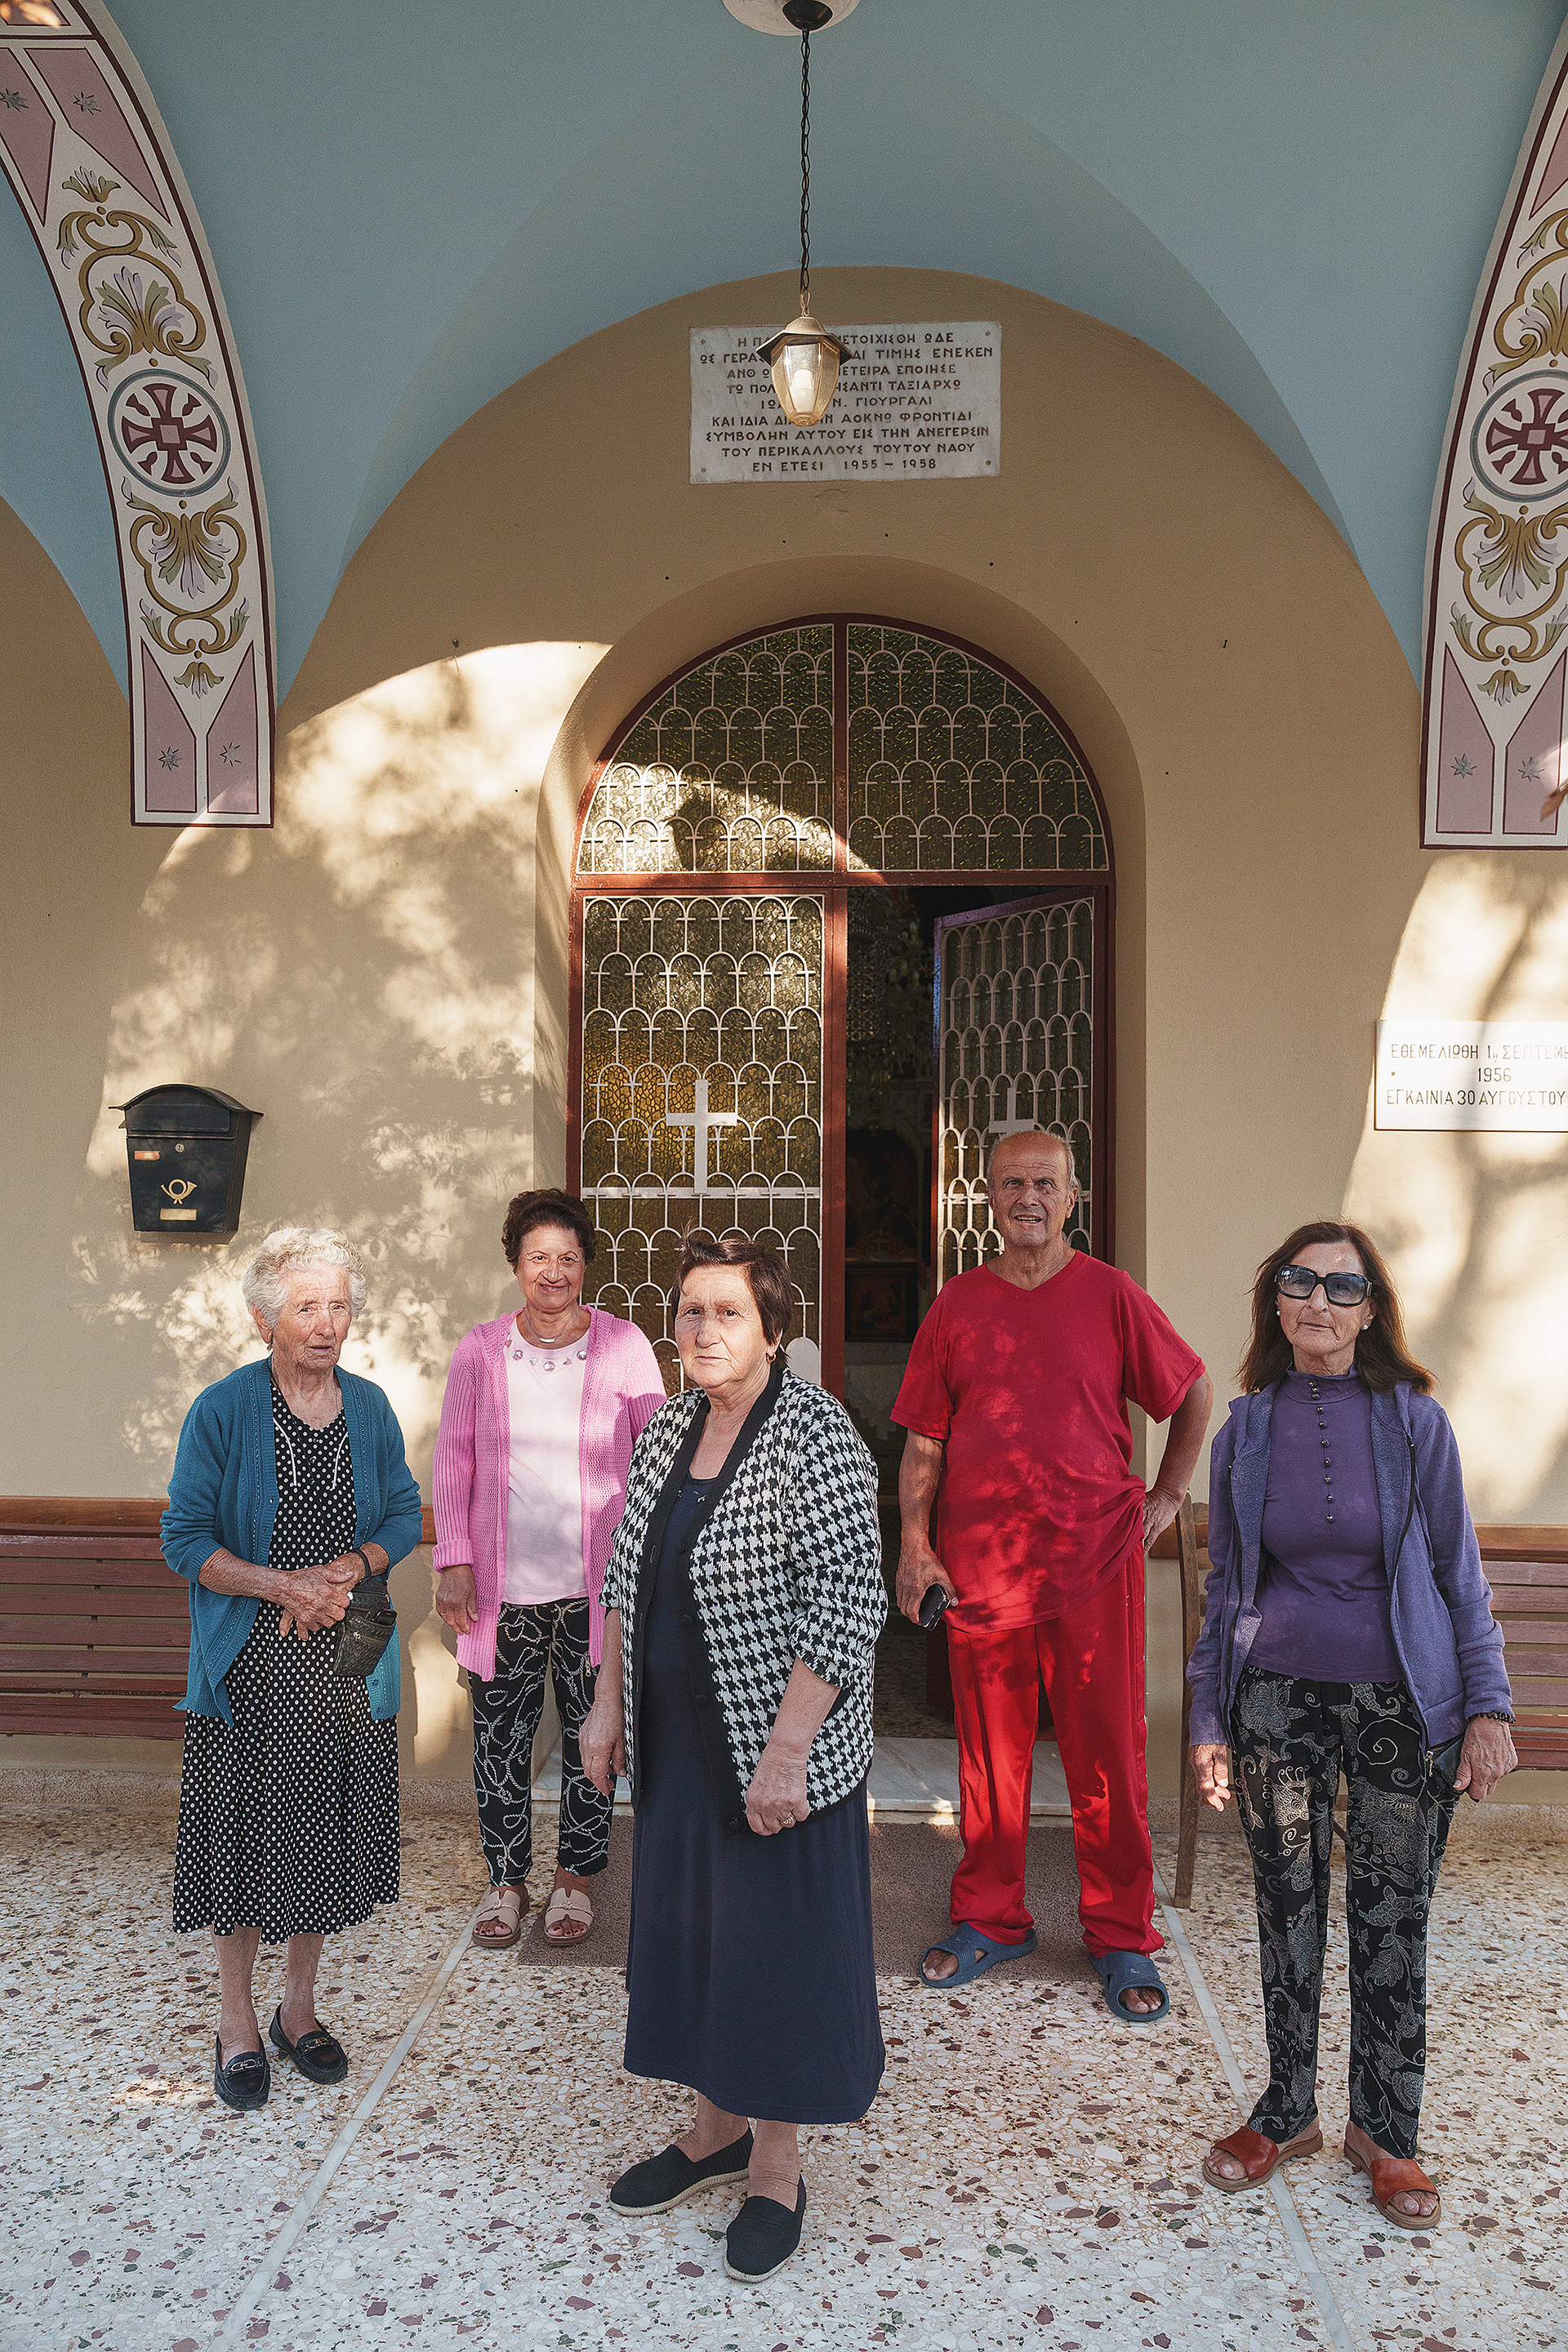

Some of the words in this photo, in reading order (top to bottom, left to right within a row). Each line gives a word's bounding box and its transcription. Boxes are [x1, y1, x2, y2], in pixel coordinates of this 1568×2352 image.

[738, 337, 746, 347] Η
[840, 333, 915, 345] ΕΤΟΙΧΙΣΘΗ
[924, 332, 954, 343] ΩΔΕ
[700, 354, 715, 364] ΩΣ
[852, 350, 866, 359] ΑΙ
[875, 348, 920, 359] ΤΙΜΗΣ
[933, 347, 993, 358] ΕΝΕΚΕΝ
[727, 369, 755, 379] ΑΝΘ
[838, 366, 890, 376] ΕΤΕΙΡΑ
[897, 363, 956, 375] ΕΠΟΙΗΣΕ
[727, 384, 743, 394] ΤΩ
[750, 384, 777, 394] ΠΟΛ
[889, 379, 960, 390] ΤΑΞΙΑΡΧΩ
[833, 398, 848, 408] Ν.
[856, 396, 933, 407] ΓΙΟΥΡΓΑΛΙ
[712, 416, 734, 427] ΚΑΙ
[741, 416, 768, 426] ΙΔΙΑ
[899, 411, 972, 422] ΦΡΟΝΤΙΔΙ
[706, 431, 788, 443] ΣΥΜΒΟΛΗΝ
[795, 430, 846, 440] ΑΥΤΟΥ
[853, 428, 874, 439] ΕΙΣ
[881, 428, 910, 439] ΤΗΝ
[916, 426, 989, 439] ΑΝΕΓΕΡΣΙΝ
[721, 448, 752, 457] ΤΟΥ
[758, 445, 863, 457] ΠΕΡΙΚΑΛΛΟΥΣ
[873, 443, 931, 454] ΤΟΥΤΟΥ
[937, 443, 975, 453] ΝΑΟΥ
[752, 462, 773, 473] ΕΝ
[781, 461, 823, 472] ΕΤΕΣΙ
[844, 459, 878, 470] 1955
[902, 458, 937, 470] 1958
[1391, 1044, 1479, 1059] ΕΘΕΜΕΛΙΩΘΗ
[1477, 1067, 1512, 1083] 1956
[1387, 1089, 1454, 1106] ΕΓΚΑΙΝΙΑ
[1456, 1089, 1477, 1106] 30
[1478, 1090, 1566, 1106] ΑΥΓΟΥΣΤΟΥ
